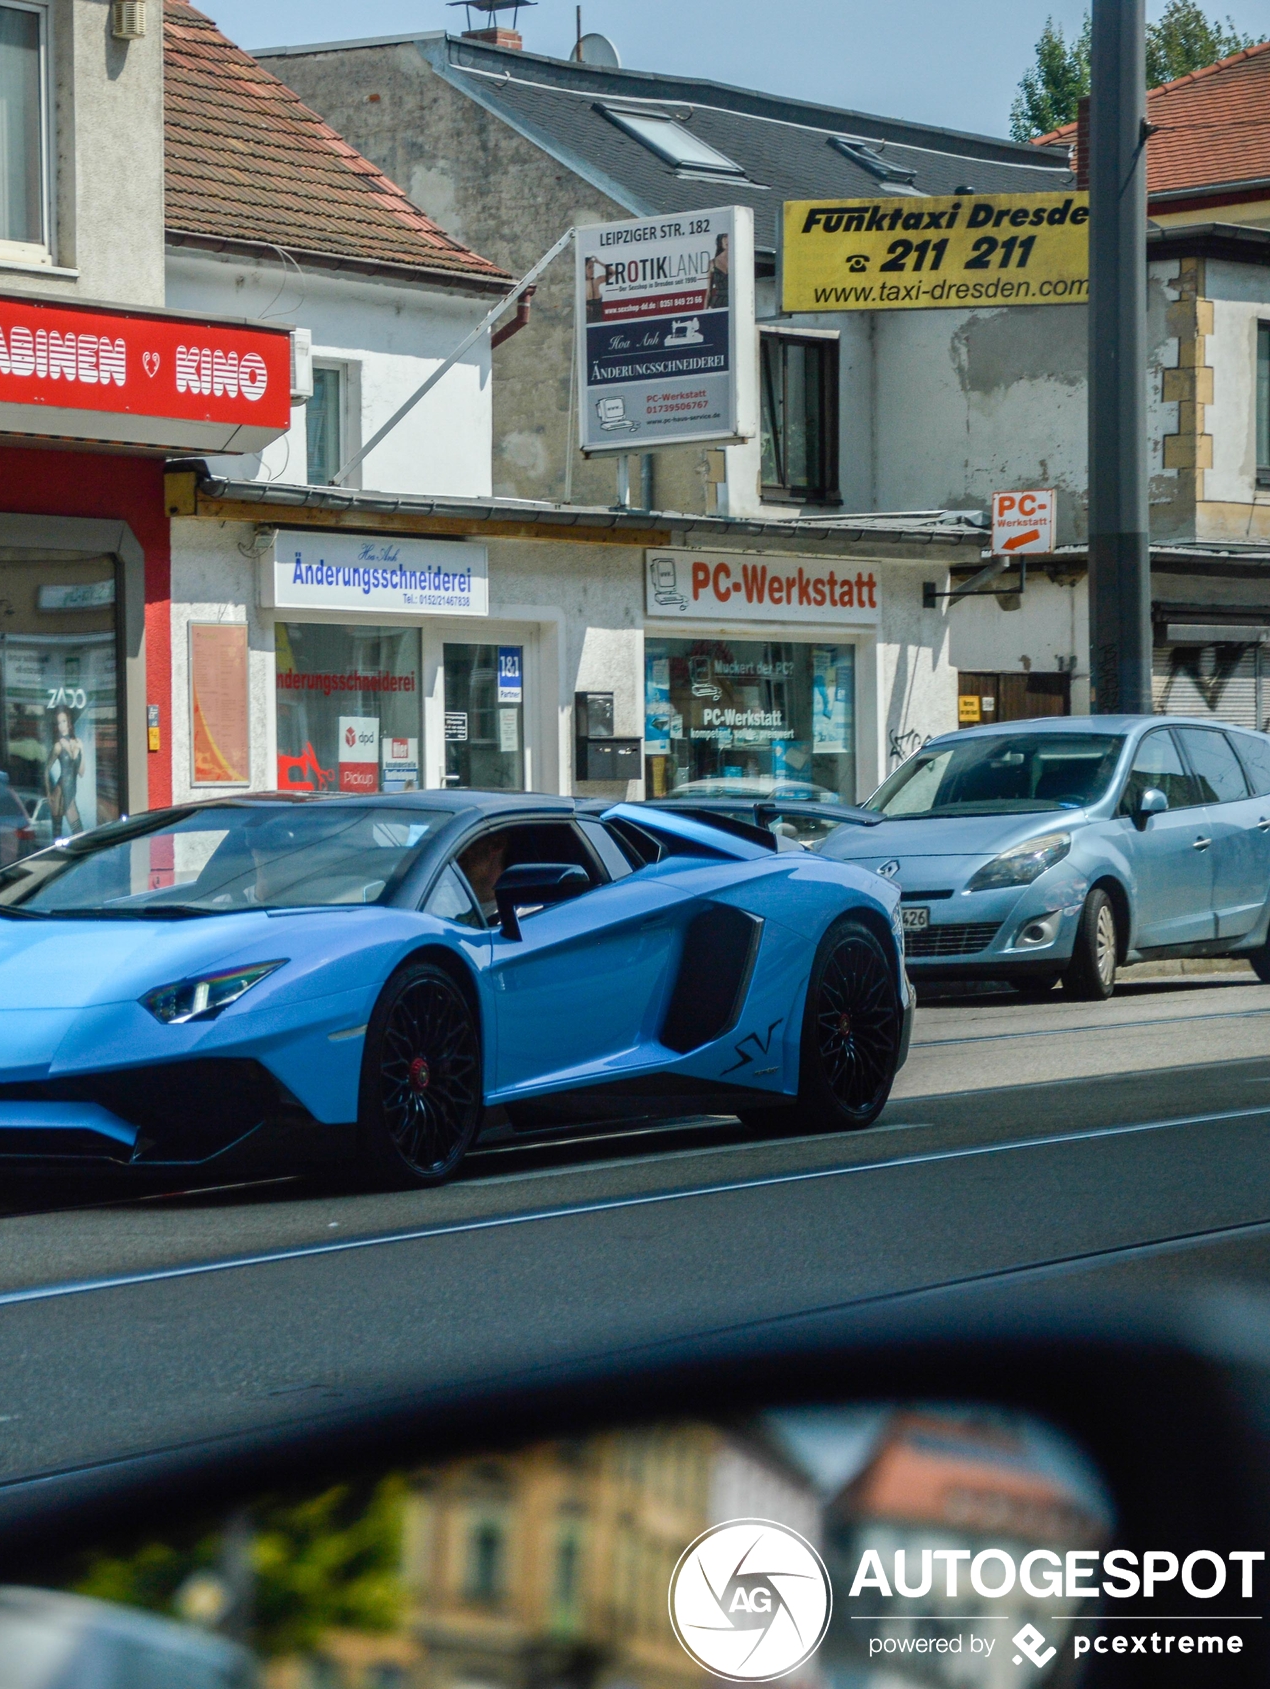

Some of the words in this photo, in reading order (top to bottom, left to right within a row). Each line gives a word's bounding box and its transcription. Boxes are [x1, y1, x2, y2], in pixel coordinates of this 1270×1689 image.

[801, 202, 962, 234] Funktaxi
[966, 199, 1089, 229] Dresde
[600, 226, 657, 247] LEIPZIGER
[660, 222, 686, 239] STR.
[689, 218, 711, 236] 182
[879, 238, 950, 273] 211
[963, 235, 1037, 270] 211
[605, 250, 711, 286] EROTIKLAND
[813, 277, 1089, 303] www.taxi-dresden.com
[604, 301, 656, 315] www.sexshop-dd.de
[685, 296, 694, 305] 23
[608, 334, 631, 350] Hoa
[176, 344, 268, 401] KINO
[646, 389, 707, 403] PC-Werkstatt
[646, 400, 709, 414] 01739506767
[997, 494, 1047, 518] PC-
[997, 517, 1048, 528] Werkstatt
[292, 552, 472, 595] Änderungsschneiderei
[691, 561, 878, 609] PC-Werkstatt
[403, 593, 418, 605] Tel.:
[500, 655, 520, 678] 1&1
[276, 667, 416, 696] nderungsschneiderei
[500, 689, 521, 700] Partner
[703, 708, 783, 727] PC-Werkstatt
[358, 730, 375, 745] dpd
[343, 769, 374, 787] Pickup
